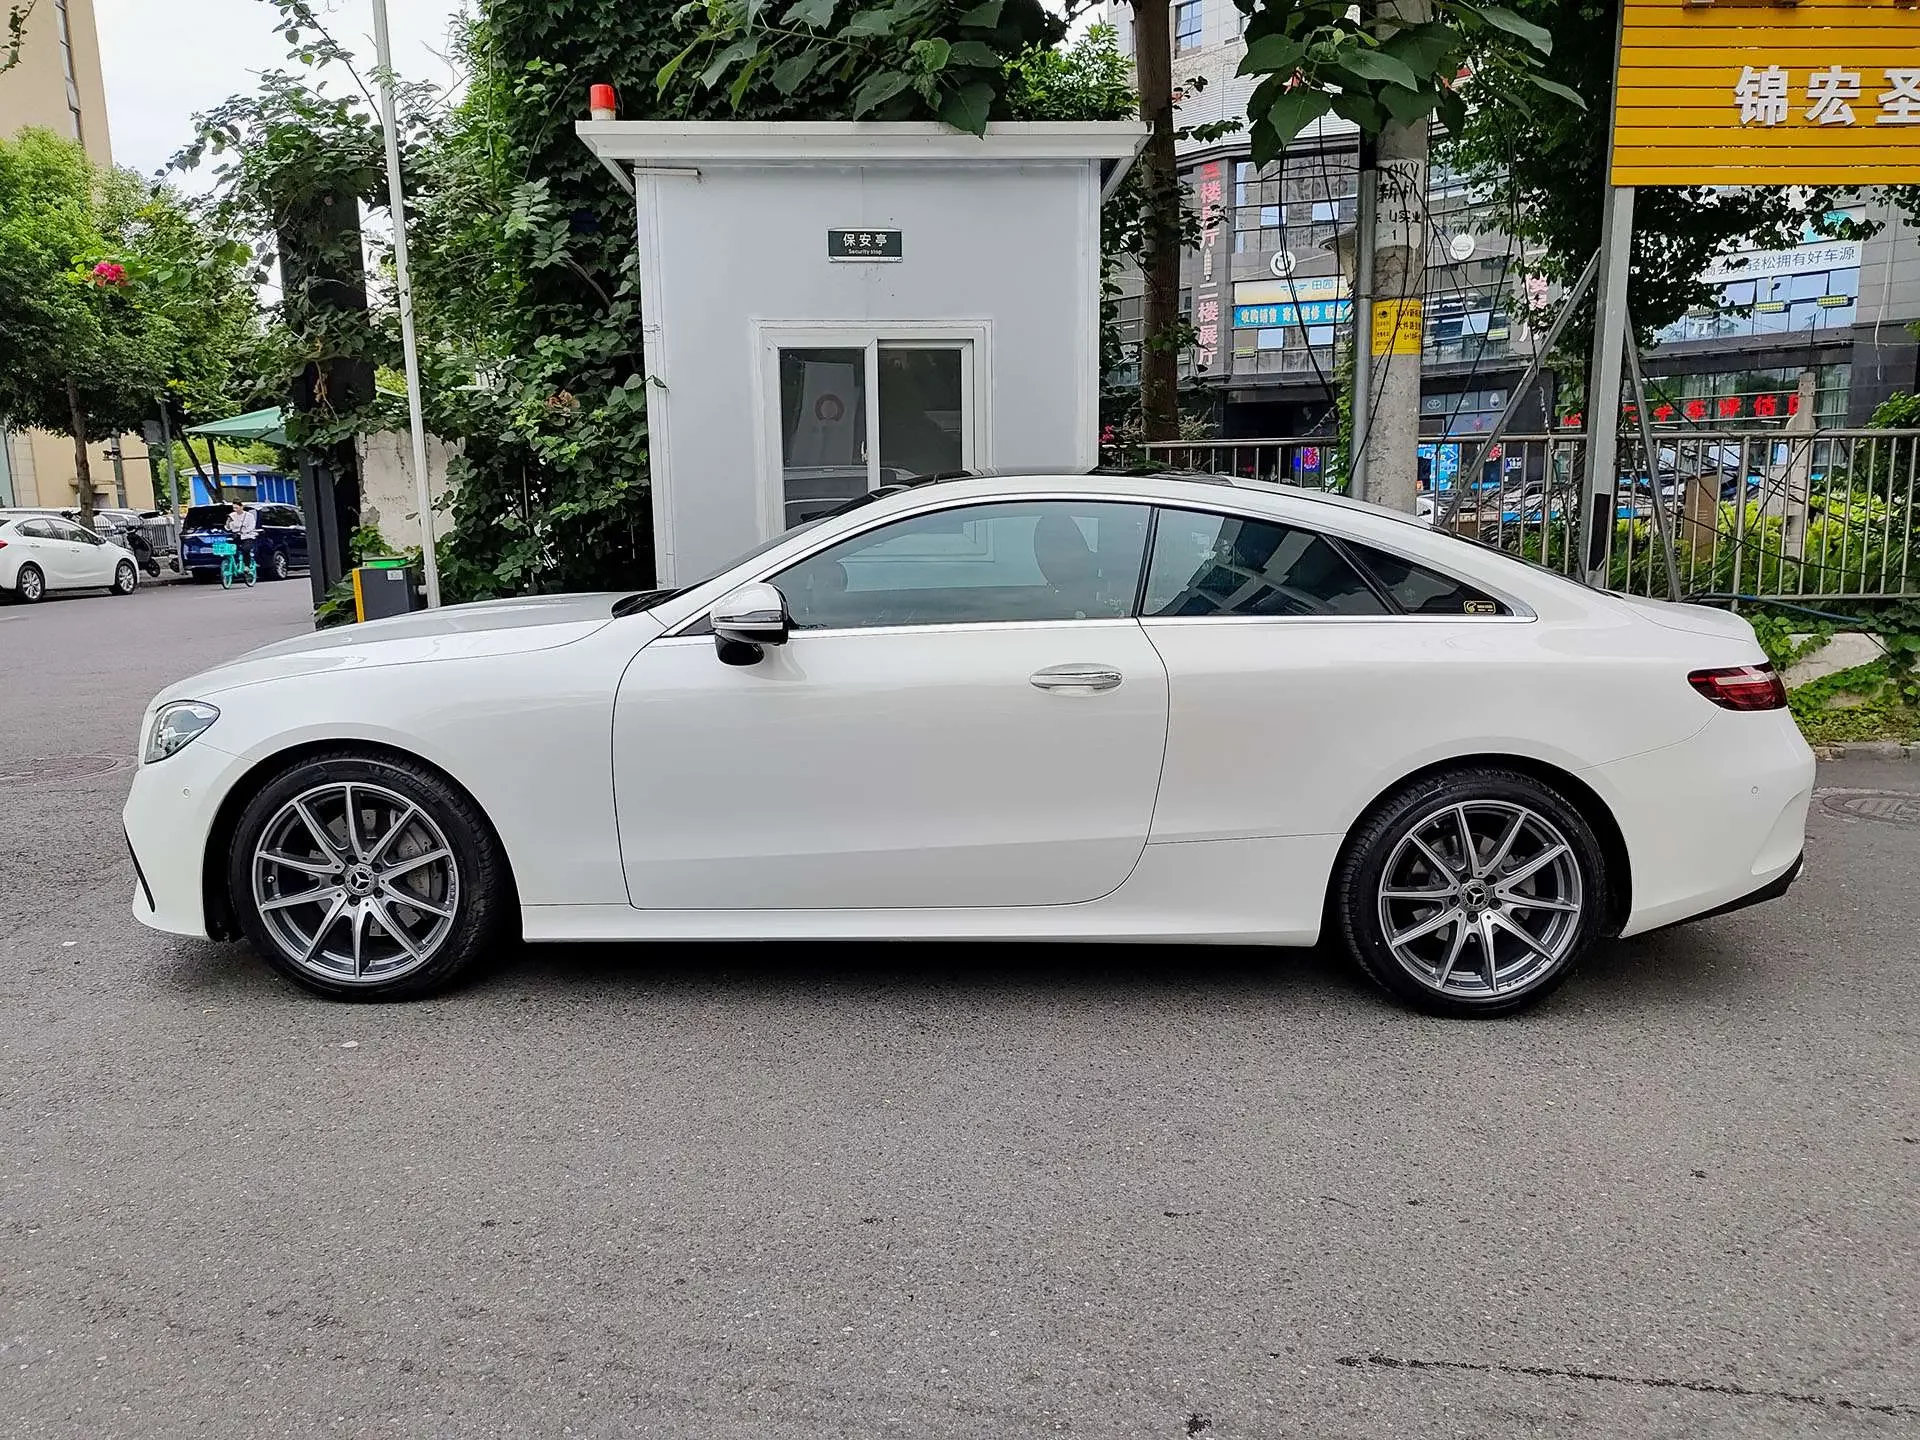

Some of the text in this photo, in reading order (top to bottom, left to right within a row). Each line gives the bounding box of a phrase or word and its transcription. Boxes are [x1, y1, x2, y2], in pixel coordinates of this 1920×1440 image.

[1734, 64, 1920, 127] 锦宏圣
[843, 233, 887, 247] 保安亭
[1196, 282, 1219, 366] 二楼展厅
